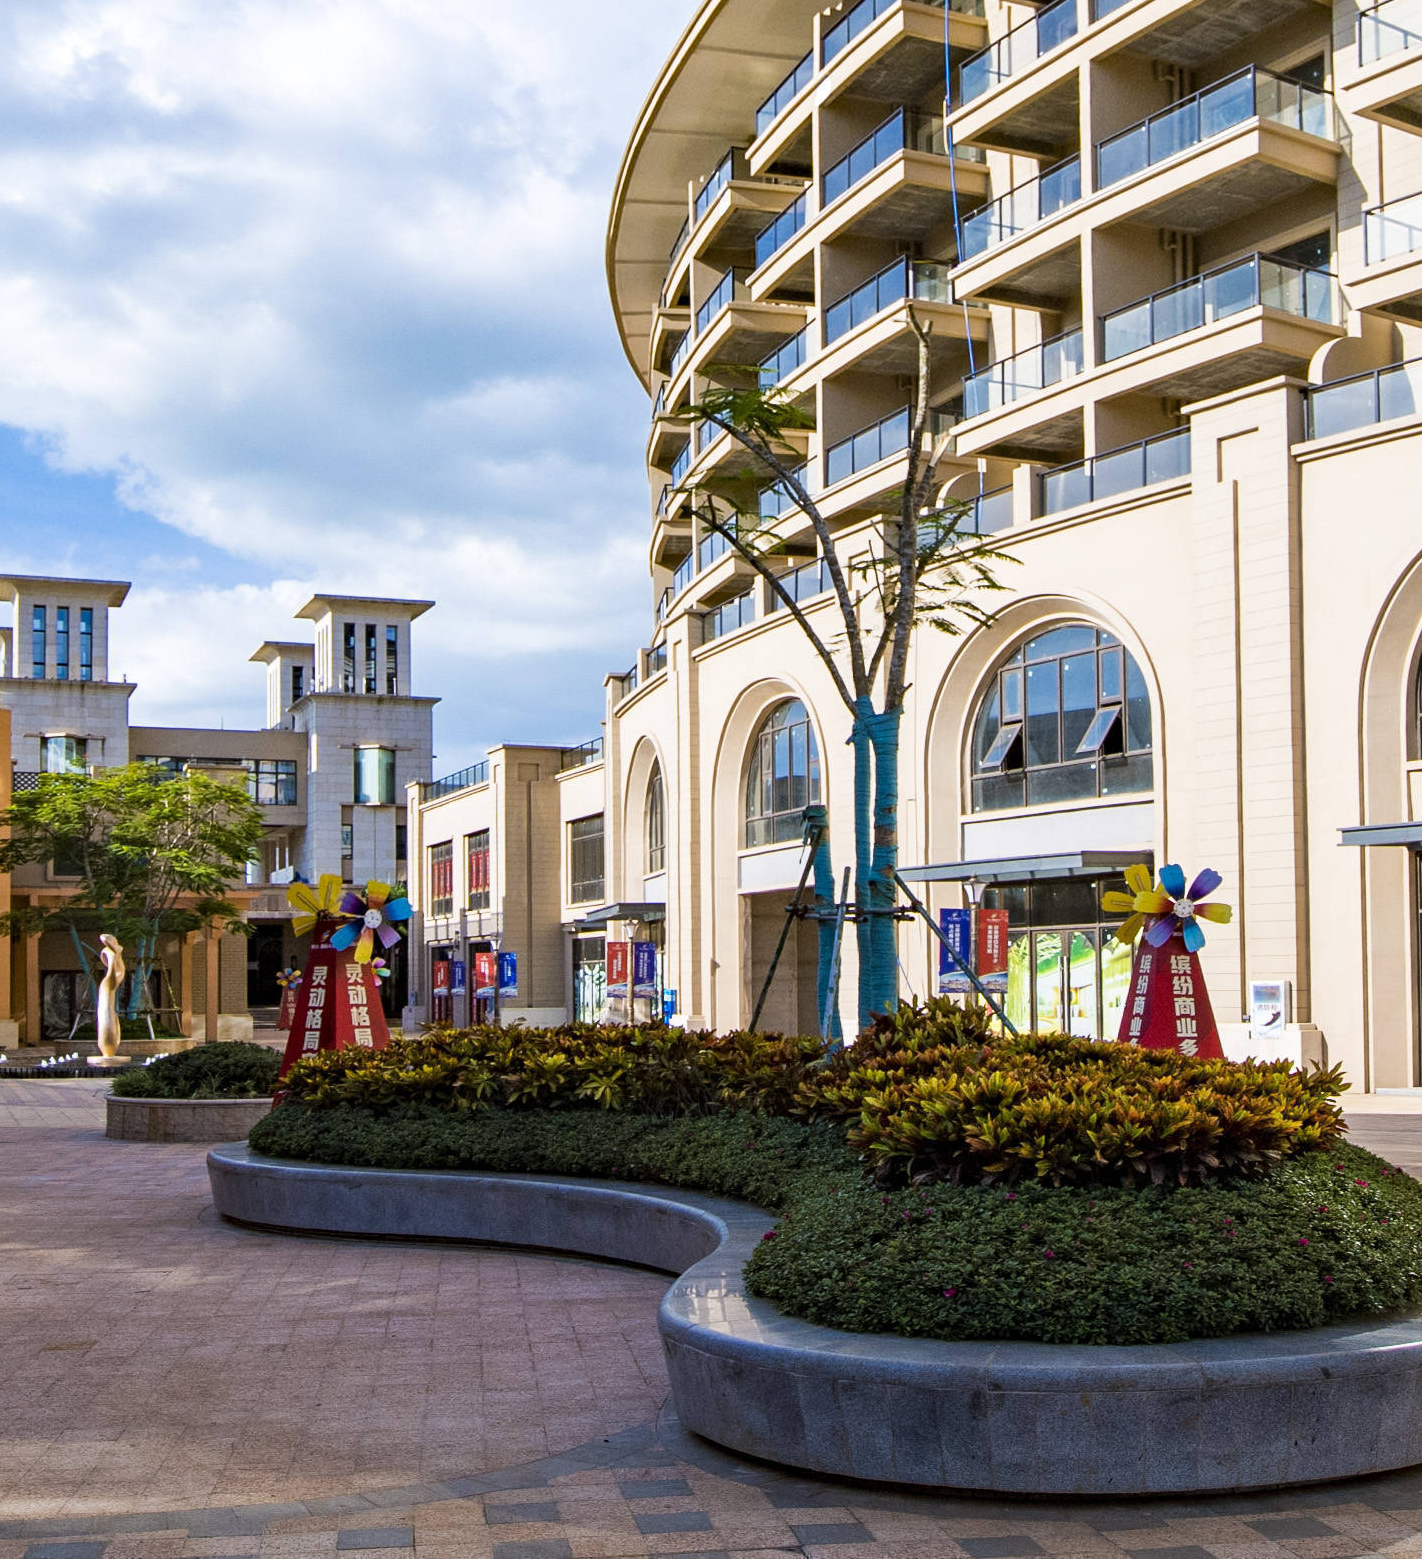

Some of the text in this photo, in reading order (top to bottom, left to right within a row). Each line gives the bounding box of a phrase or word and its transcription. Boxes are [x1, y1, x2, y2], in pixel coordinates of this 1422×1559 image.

[345, 963, 374, 1048] 灵动格局
[1170, 955, 1198, 1057] 缤纷商业多
